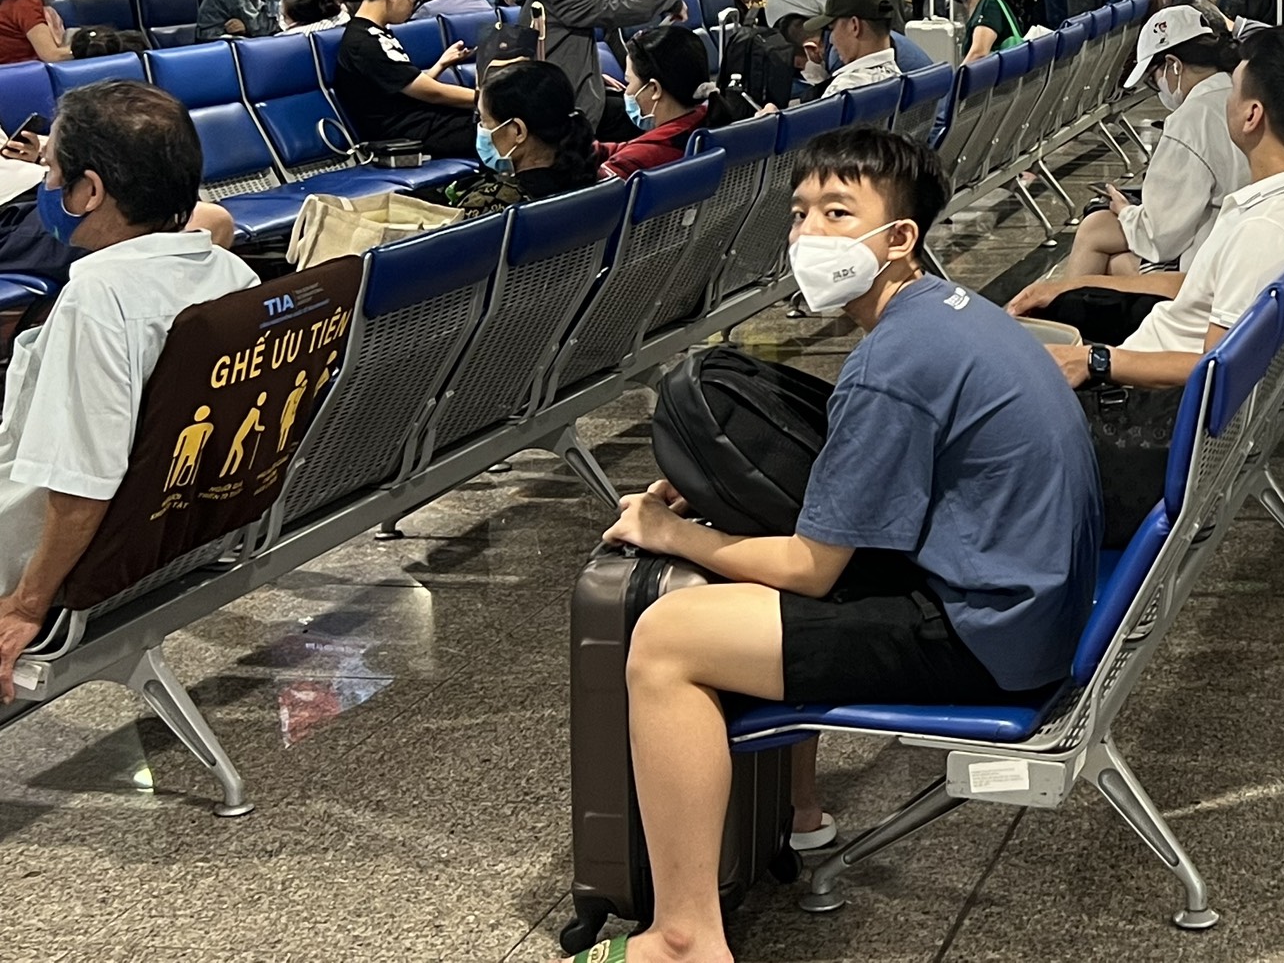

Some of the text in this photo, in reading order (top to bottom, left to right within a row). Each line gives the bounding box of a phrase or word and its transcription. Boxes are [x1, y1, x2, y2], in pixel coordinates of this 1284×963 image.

[263, 294, 294, 316] TIA
[211, 330, 271, 388] GHẾ
[271, 329, 303, 369] ƯU
[308, 306, 353, 354] TIÊN
